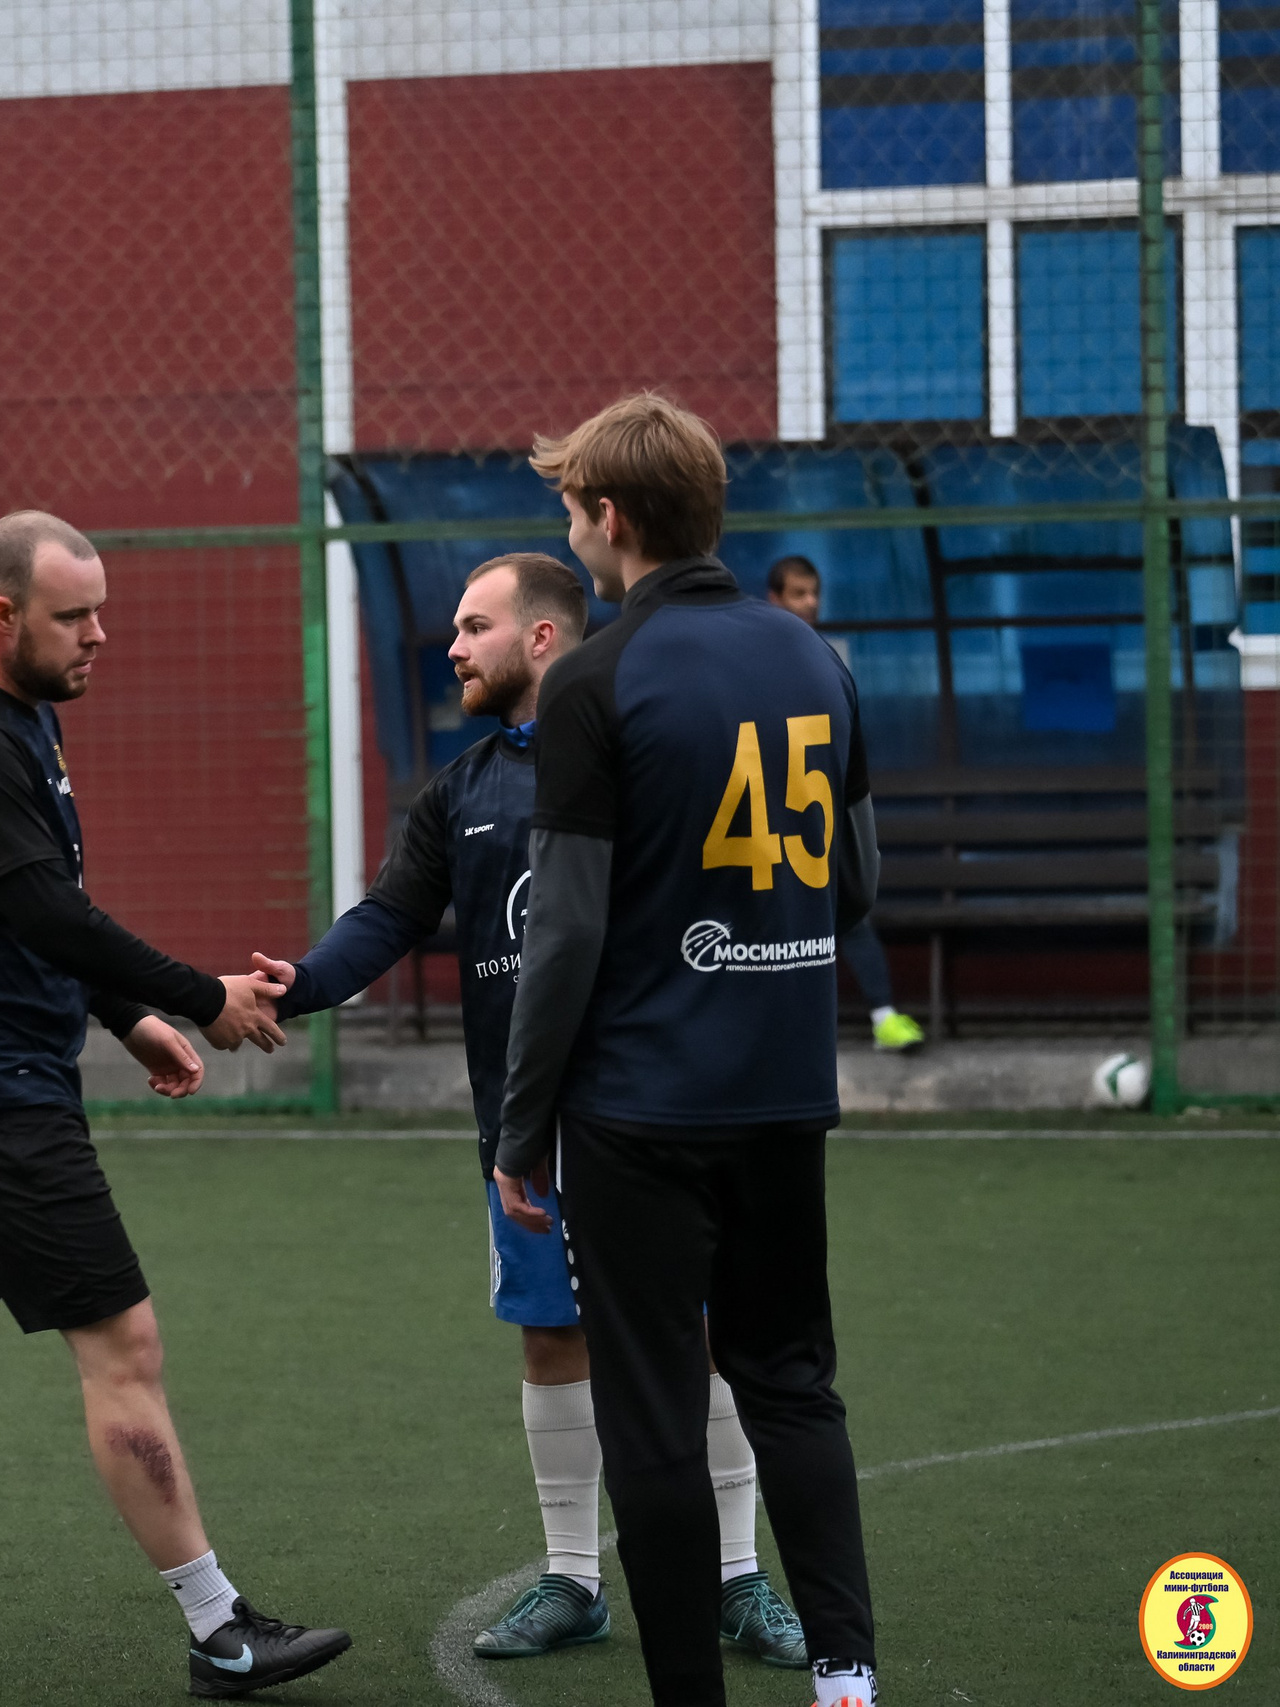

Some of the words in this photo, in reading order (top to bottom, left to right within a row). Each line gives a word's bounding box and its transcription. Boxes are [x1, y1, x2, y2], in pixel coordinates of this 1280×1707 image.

[702, 714, 834, 890] 45
[474, 823, 495, 834] SPORT
[726, 964, 772, 972] РЕГИОНАЛЬНАЯ
